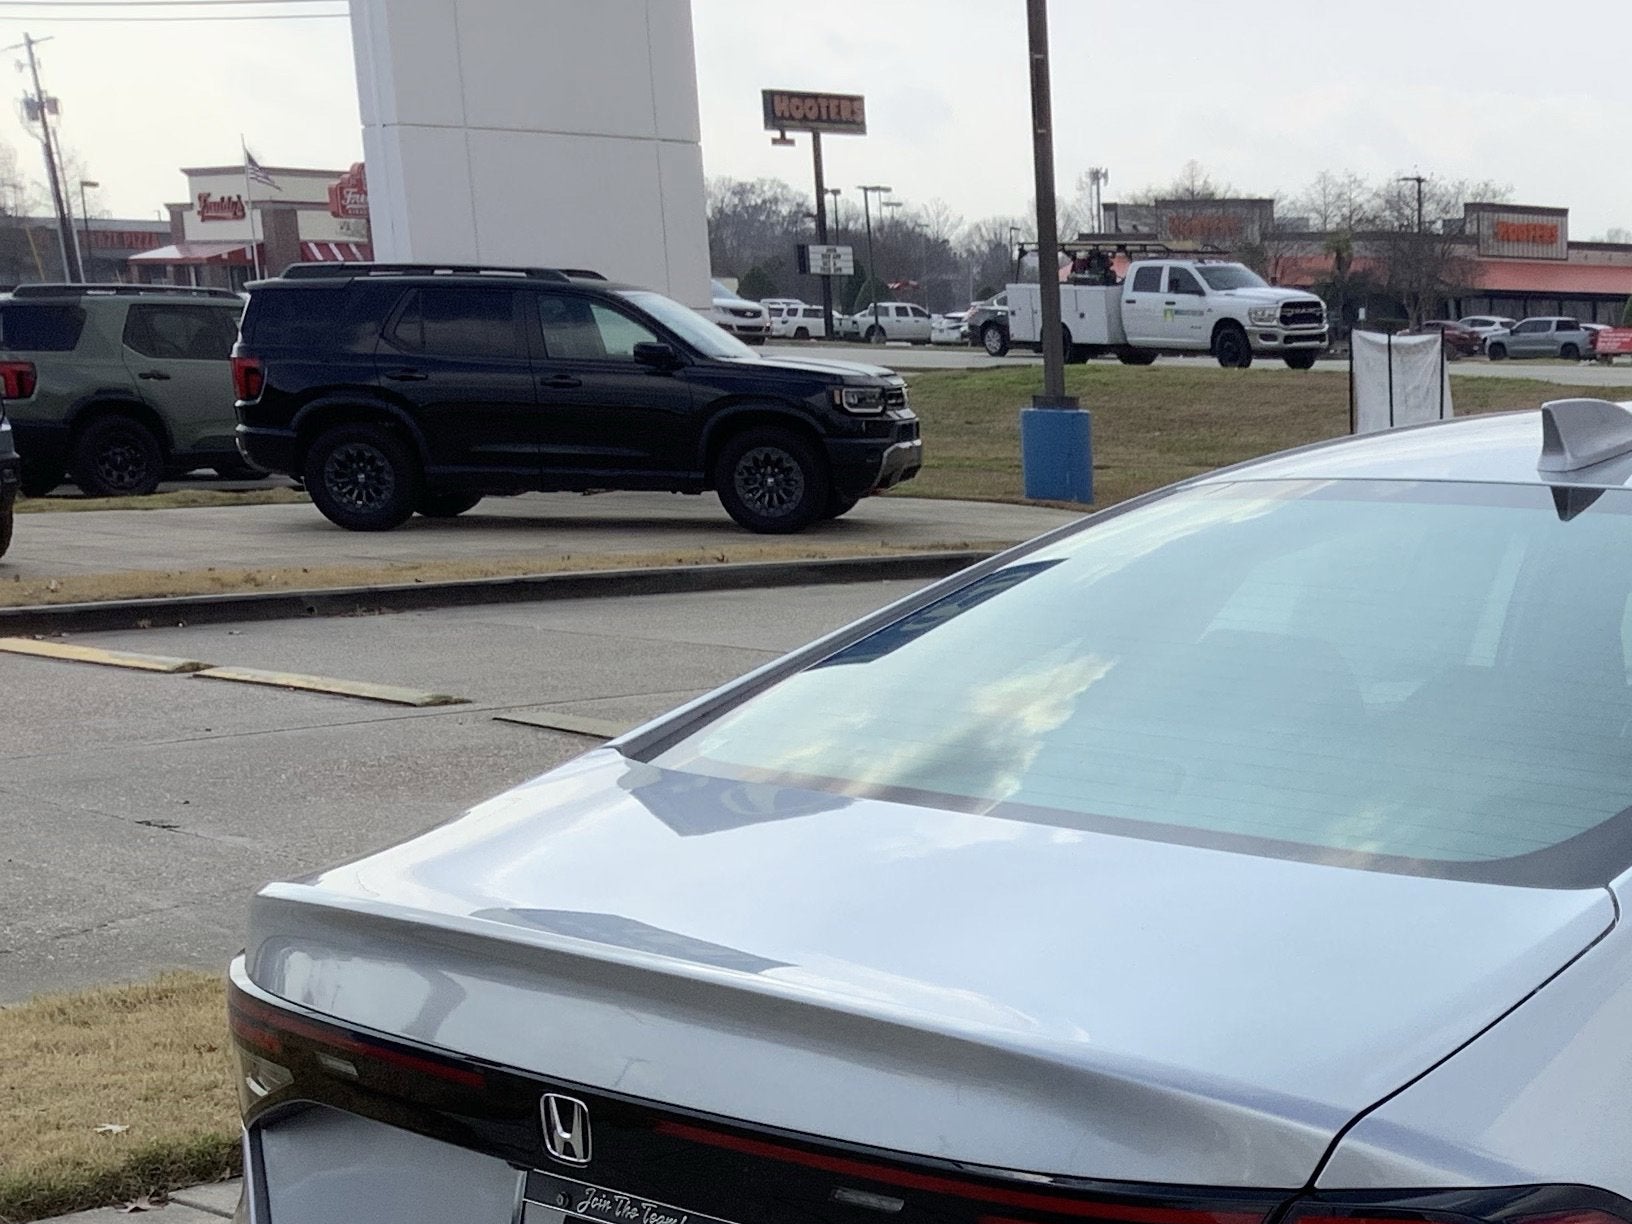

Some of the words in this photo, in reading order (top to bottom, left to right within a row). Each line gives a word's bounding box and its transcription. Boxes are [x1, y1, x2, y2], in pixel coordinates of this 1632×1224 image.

[773, 94, 866, 123] HOOTERS
[576, 1187, 612, 1213] Join
[614, 1195, 639, 1220] The
